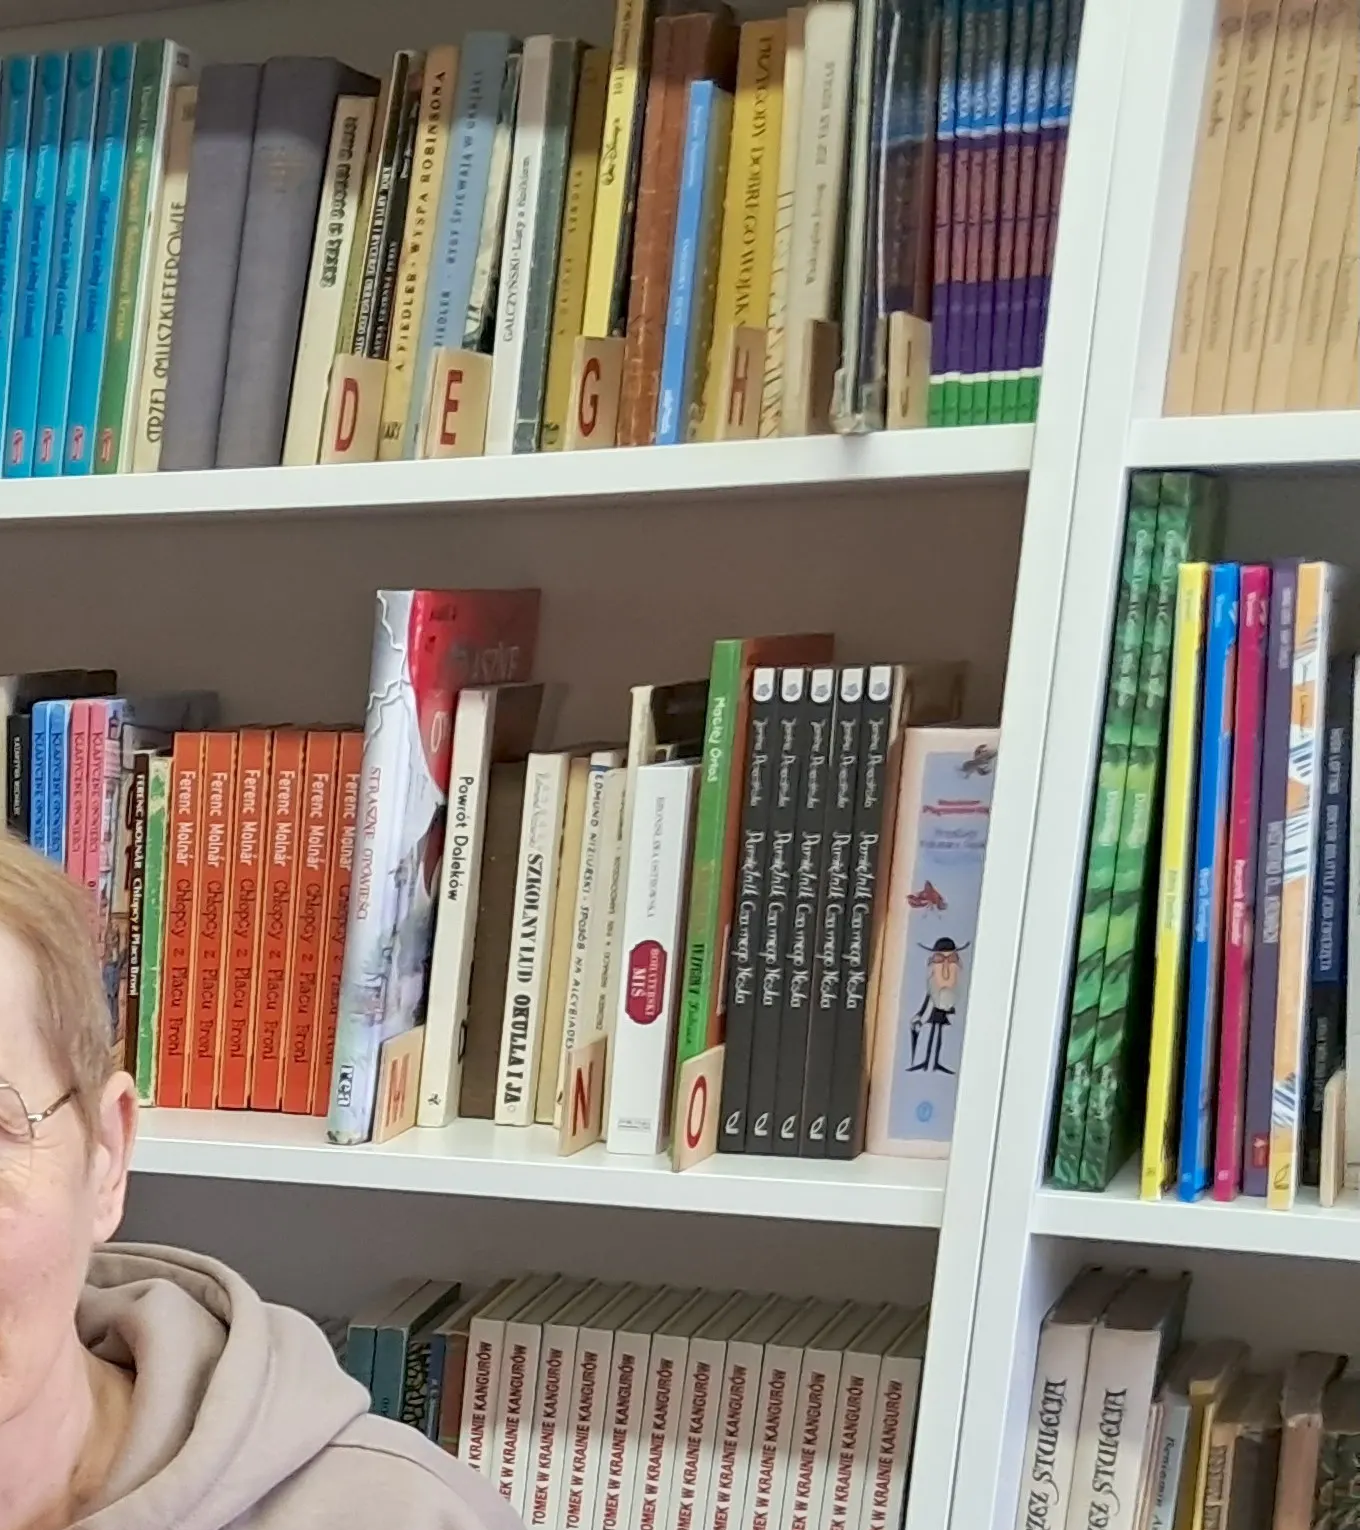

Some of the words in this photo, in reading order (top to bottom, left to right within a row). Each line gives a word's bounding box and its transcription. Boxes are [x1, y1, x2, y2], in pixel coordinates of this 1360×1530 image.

[752, 37, 772, 137] PRZYGODY
[398, 274, 416, 351] FIEDLER
[411, 198, 426, 253] WYSPA
[421, 71, 445, 182] ROBINSONA
[743, 147, 762, 243] DOBREGO
[440, 370, 463, 445] E
[579, 357, 600, 436] G
[729, 346, 750, 425] H
[334, 377, 358, 451] D
[707, 696, 726, 743] Maciej
[134, 774, 145, 816] FERENC
[178, 769, 195, 814] Ferenc
[209, 771, 226, 816] Ferenc
[365, 766, 381, 839] STRASZNE
[456, 776, 474, 827] Powrót
[590, 774, 603, 825] EDMUND
[177, 821, 194, 865] Molnár
[206, 823, 223, 867] Molnár
[448, 835, 469, 901] Daleków
[583, 833, 597, 890] NIZIURSKI
[129, 877, 142, 922] Chłopcy
[170, 878, 192, 937] Chłopcy
[201, 880, 221, 939] Chłopcy
[358, 847, 374, 921] OPOWIEŚCI
[521, 854, 541, 938] SZKOLNY
[129, 933, 140, 963] Placu
[577, 907, 589, 948] SPOSÓB
[171, 967, 186, 1006] Placu
[201, 969, 217, 1008] Placu
[518, 947, 534, 983] LUD
[575, 957, 582, 972] NA
[632, 968, 646, 997] MIŚ
[506, 994, 531, 1068] OKULLA
[502, 1082, 522, 1106] JA
[573, 1062, 594, 1137] N
[685, 1075, 707, 1148] O
[540, 1348, 563, 1418] KANGURÓW
[575, 1351, 599, 1422] KANGURÓW
[649, 1357, 674, 1430] KANGURÓW
[537, 1421, 555, 1468] KRAINIE
[572, 1424, 590, 1473] KRAINIE
[645, 1432, 664, 1481] KRAINIE
[1033, 1381, 1065, 1485] STULECIA
[1093, 1390, 1126, 1495] STULECIA
[539, 1470, 549, 1482] W
[571, 1474, 583, 1485] W
[644, 1484, 657, 1494] W
[532, 1485, 548, 1526] TOMEK
[566, 1489, 582, 1529] TOMEK
